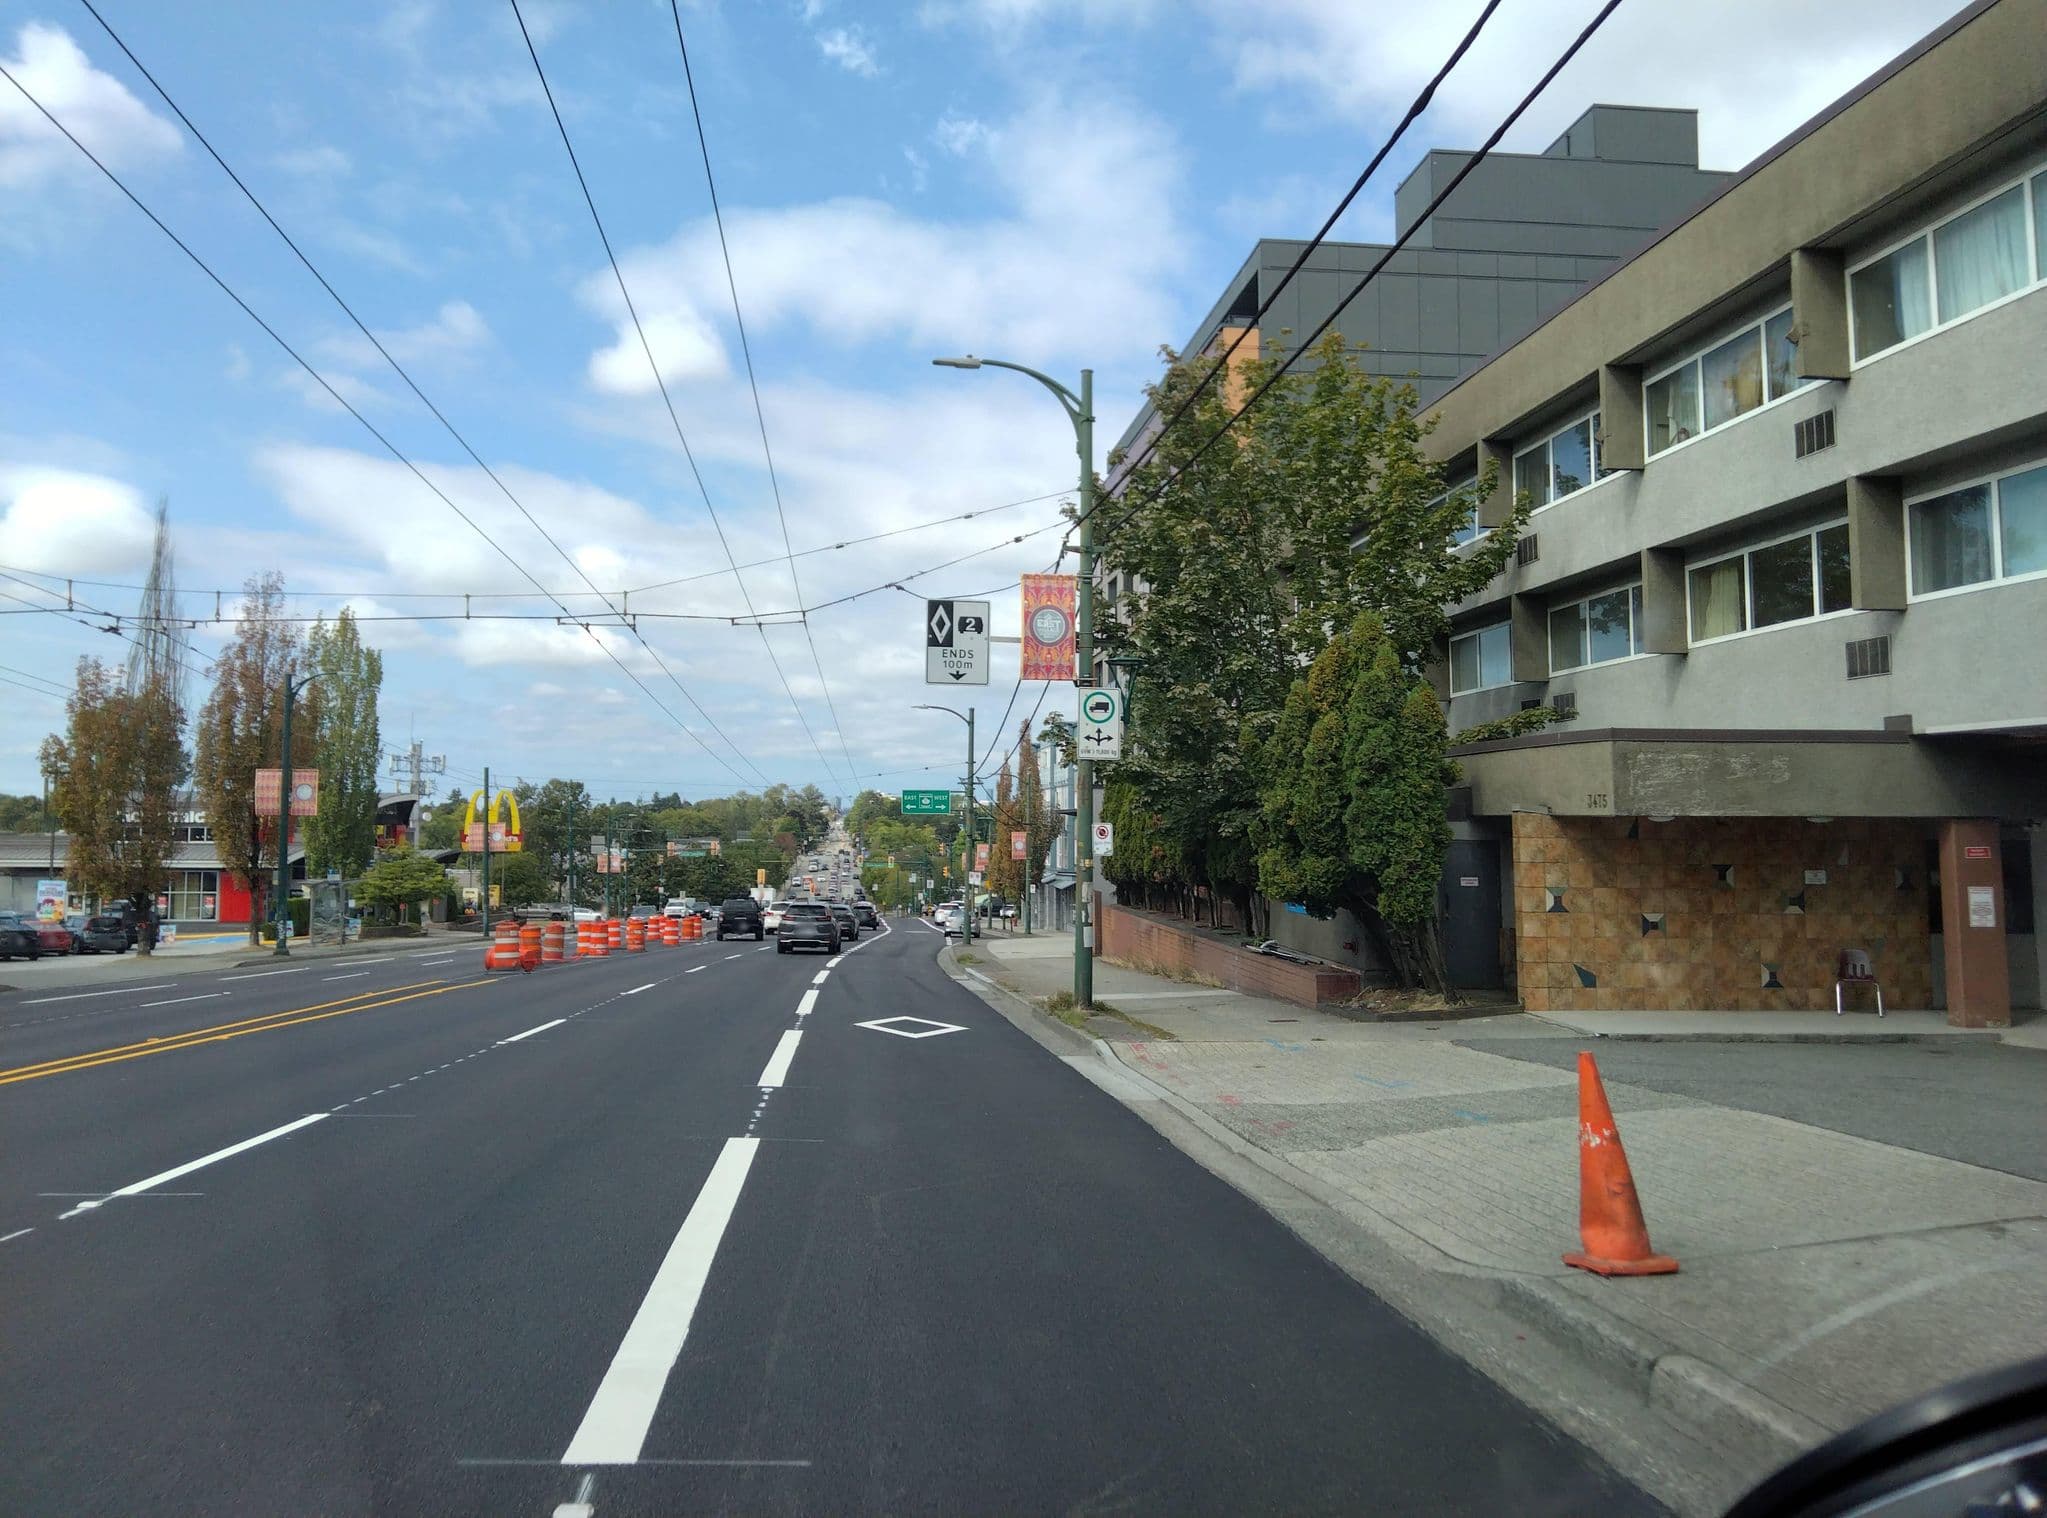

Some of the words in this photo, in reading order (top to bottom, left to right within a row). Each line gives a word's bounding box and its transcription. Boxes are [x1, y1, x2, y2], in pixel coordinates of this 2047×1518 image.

[965, 617, 976, 631] 2
[942, 649, 974, 659] ENDS
[943, 660, 973, 669] 100m
